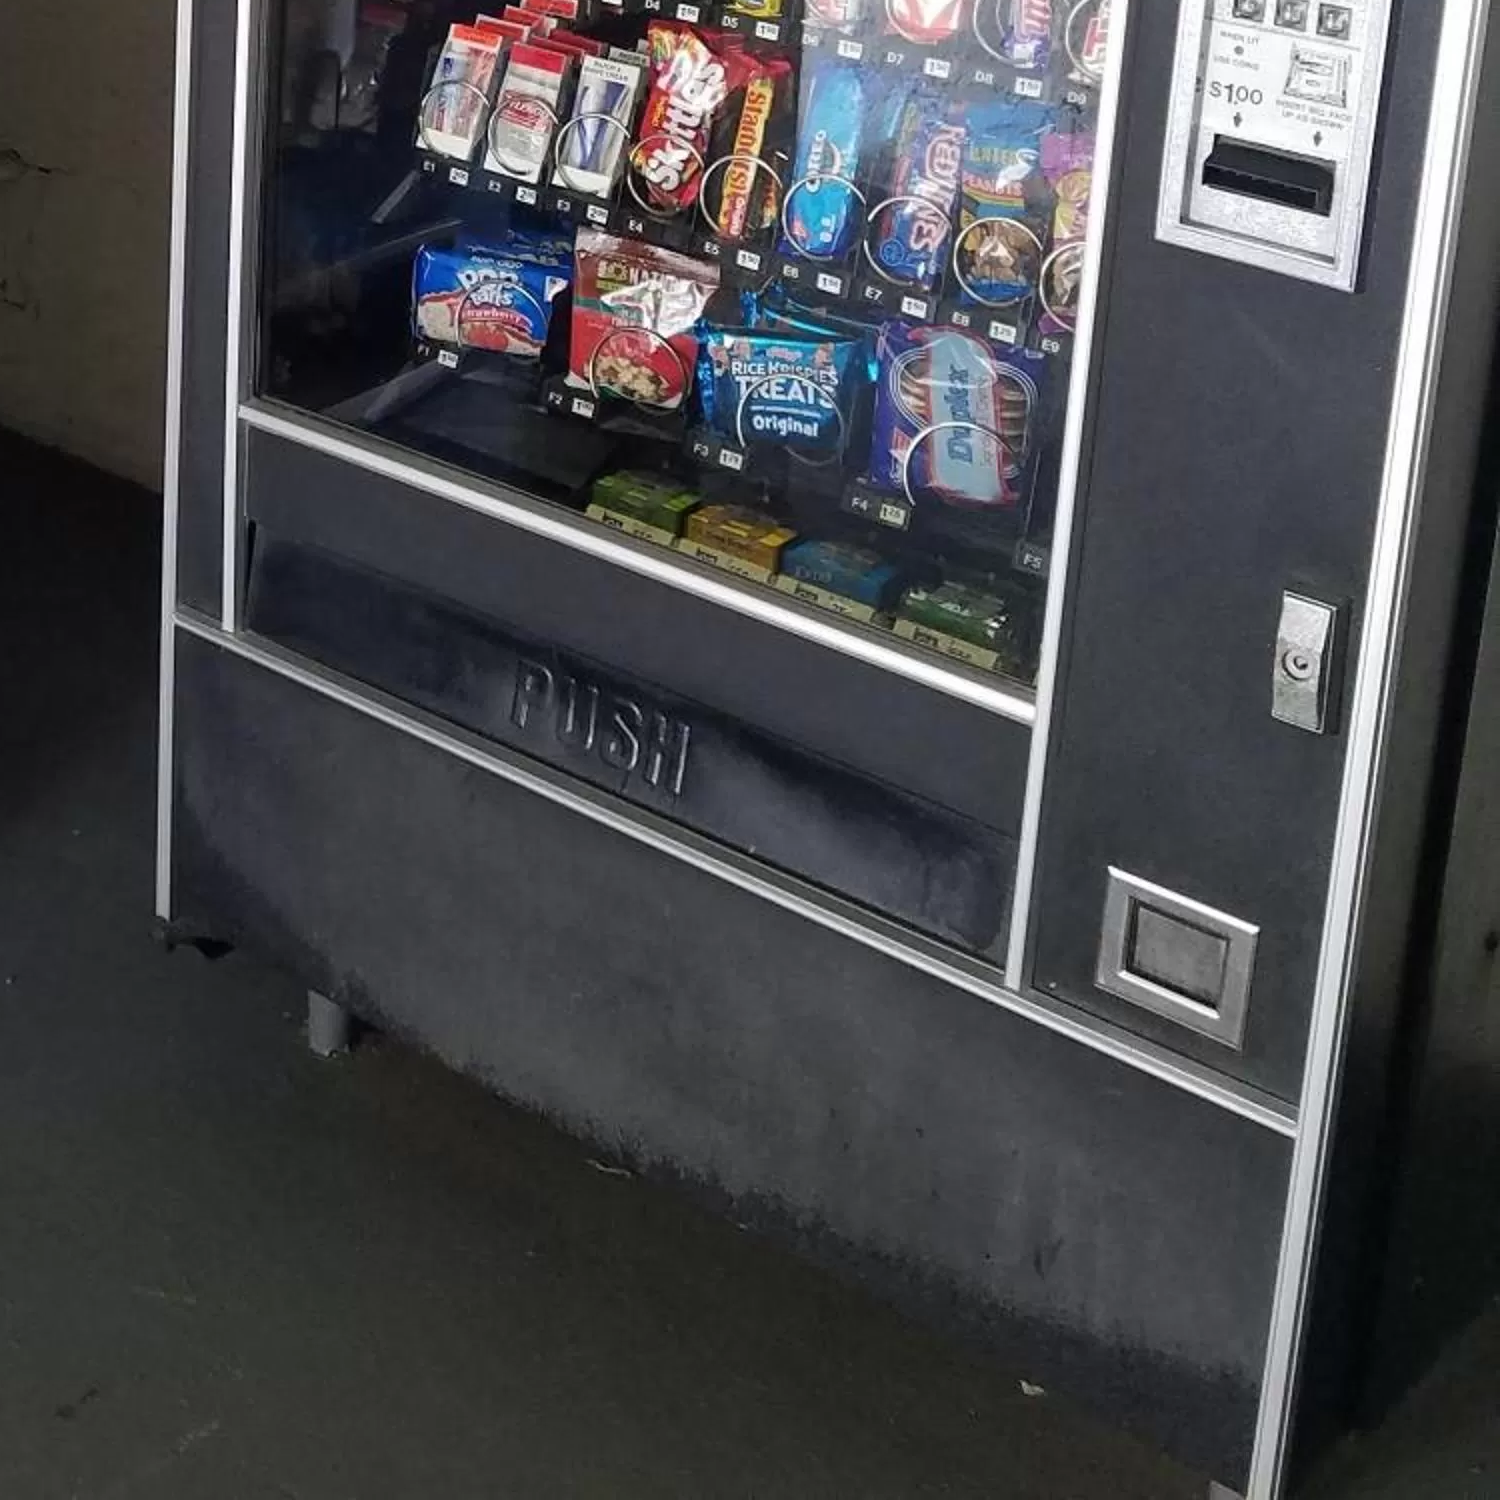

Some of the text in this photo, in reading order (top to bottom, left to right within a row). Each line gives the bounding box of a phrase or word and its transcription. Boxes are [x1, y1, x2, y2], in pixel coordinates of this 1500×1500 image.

[722, 16, 739, 28] D5
[887, 52, 905, 65] D7
[646, 52, 728, 192] Skittles
[628, 220, 644, 233] E4
[865, 287, 882, 300] E7
[1041, 339, 1060, 352] E9
[731, 360, 840, 384] RICE KRISPIES
[735, 375, 838, 410] TREATS
[752, 413, 820, 438] Original
[852, 497, 869, 511] F4
[1024, 553, 1042, 570] F5
[510, 657, 692, 797] PUSH
